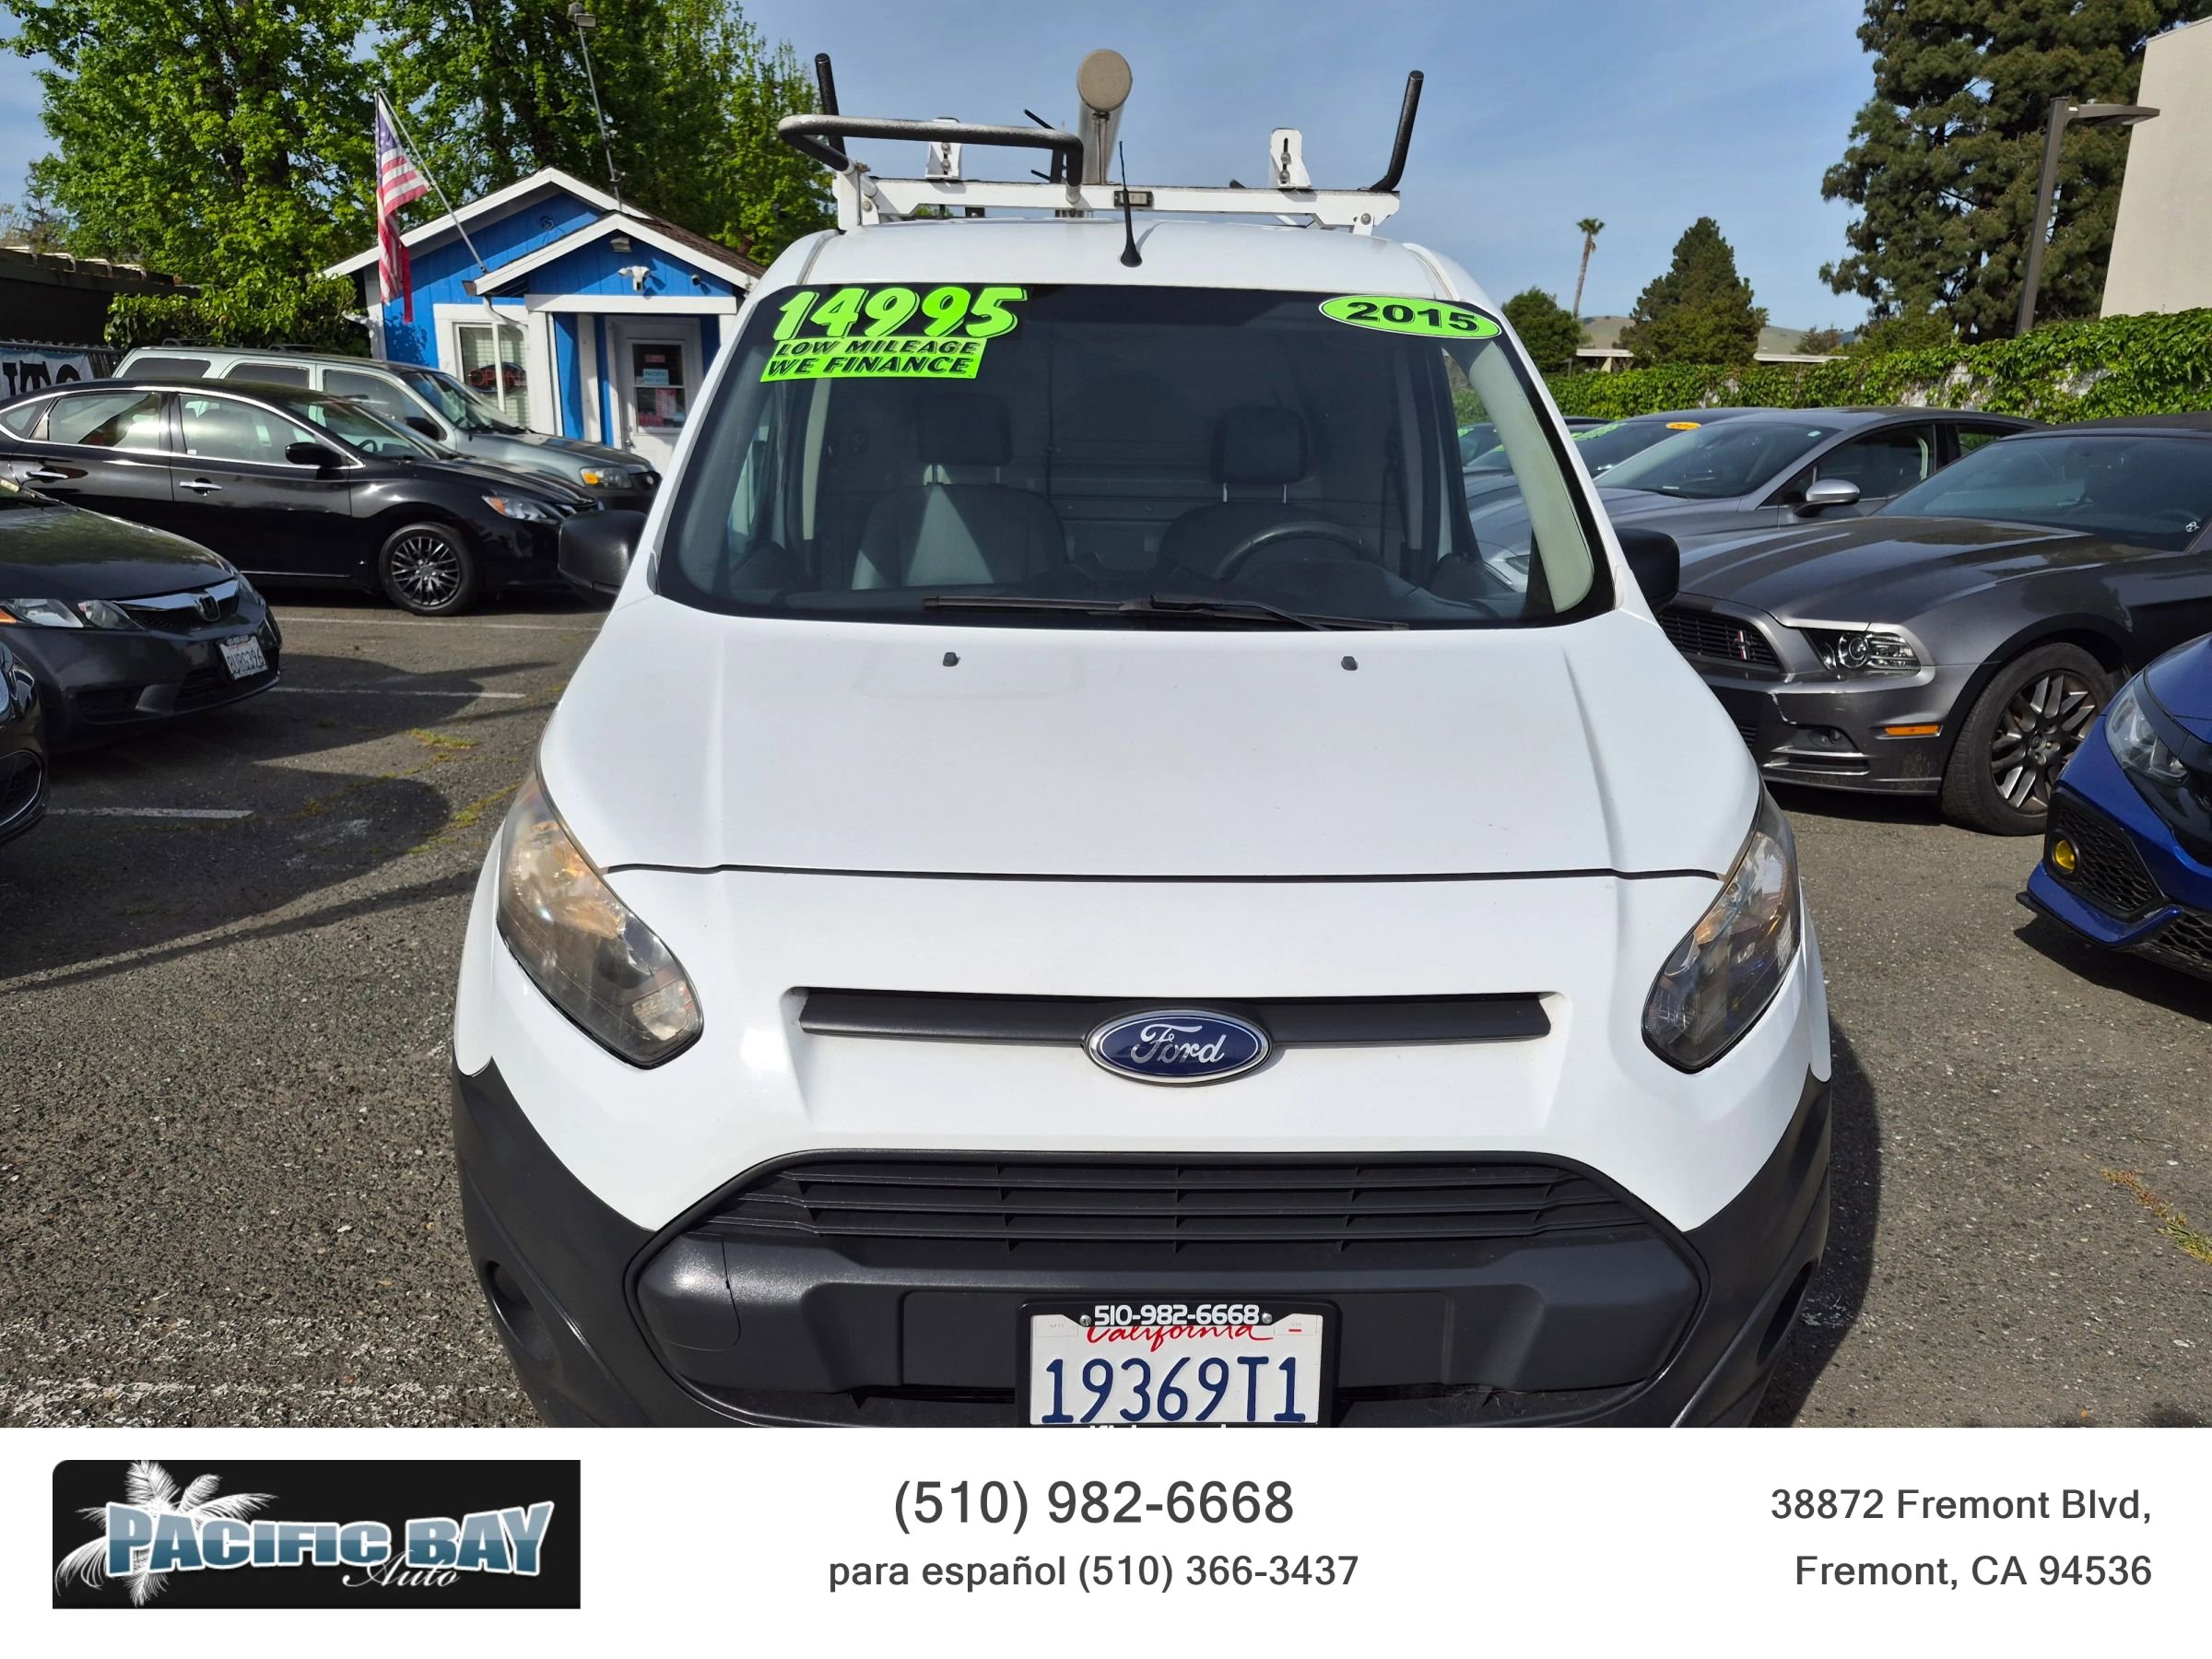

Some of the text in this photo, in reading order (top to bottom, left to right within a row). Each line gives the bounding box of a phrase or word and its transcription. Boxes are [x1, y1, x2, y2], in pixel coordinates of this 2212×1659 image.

[772, 287, 1028, 340] 14995
[1347, 301, 1480, 332] 2015
[776, 339, 982, 357] LOW MILEAGE
[767, 356, 973, 376] WE FINANCE
[1130, 1023, 1227, 1064] Ford
[1094, 1304, 1261, 1325] 510-982-6668
[1087, 1324, 1274, 1352] California
[1041, 1356, 1306, 1423] 19369T1
